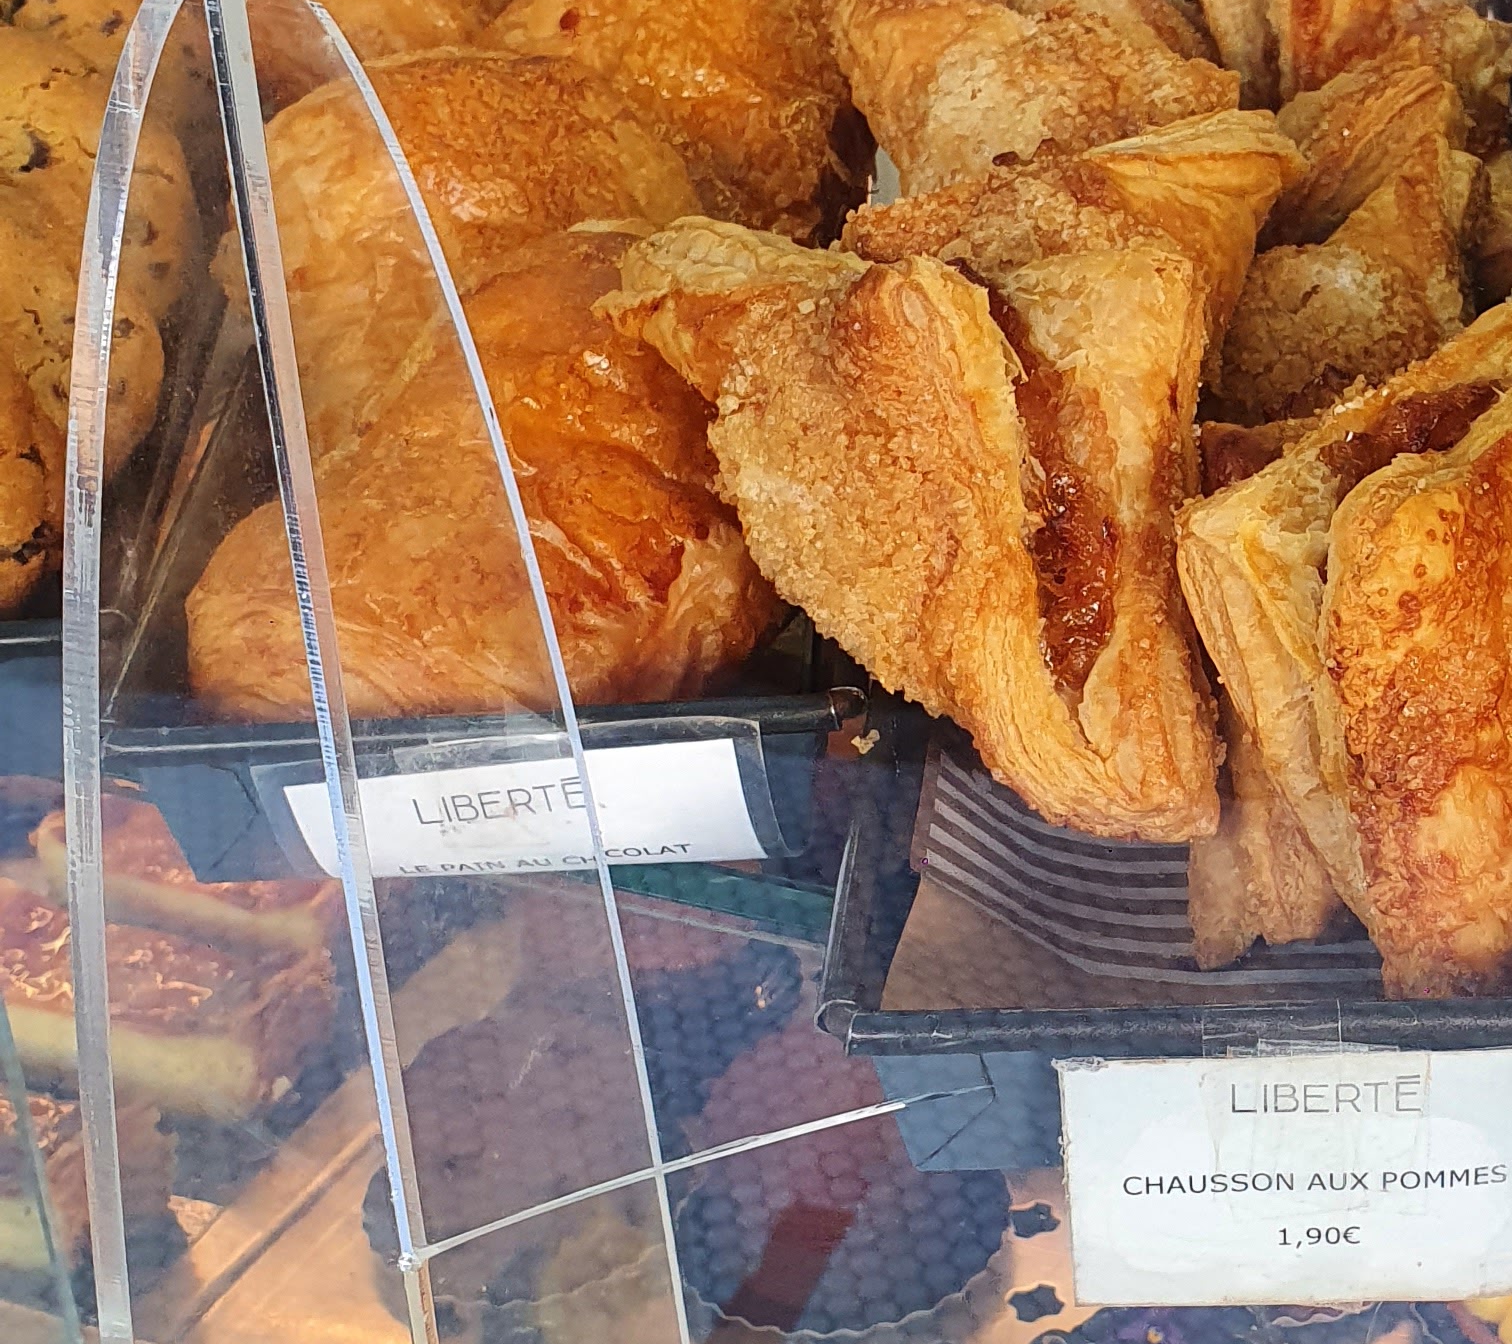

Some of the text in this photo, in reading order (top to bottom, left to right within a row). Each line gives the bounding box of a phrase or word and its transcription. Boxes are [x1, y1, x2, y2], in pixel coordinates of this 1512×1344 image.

[440, 860, 505, 873] PAIN
[517, 857, 553, 868] AU
[562, 842, 692, 866] CHCOLAT
[1122, 1164, 1508, 1197] CHAUSSON AUX POMMES
[1277, 1225, 1361, 1250] 1,90€
